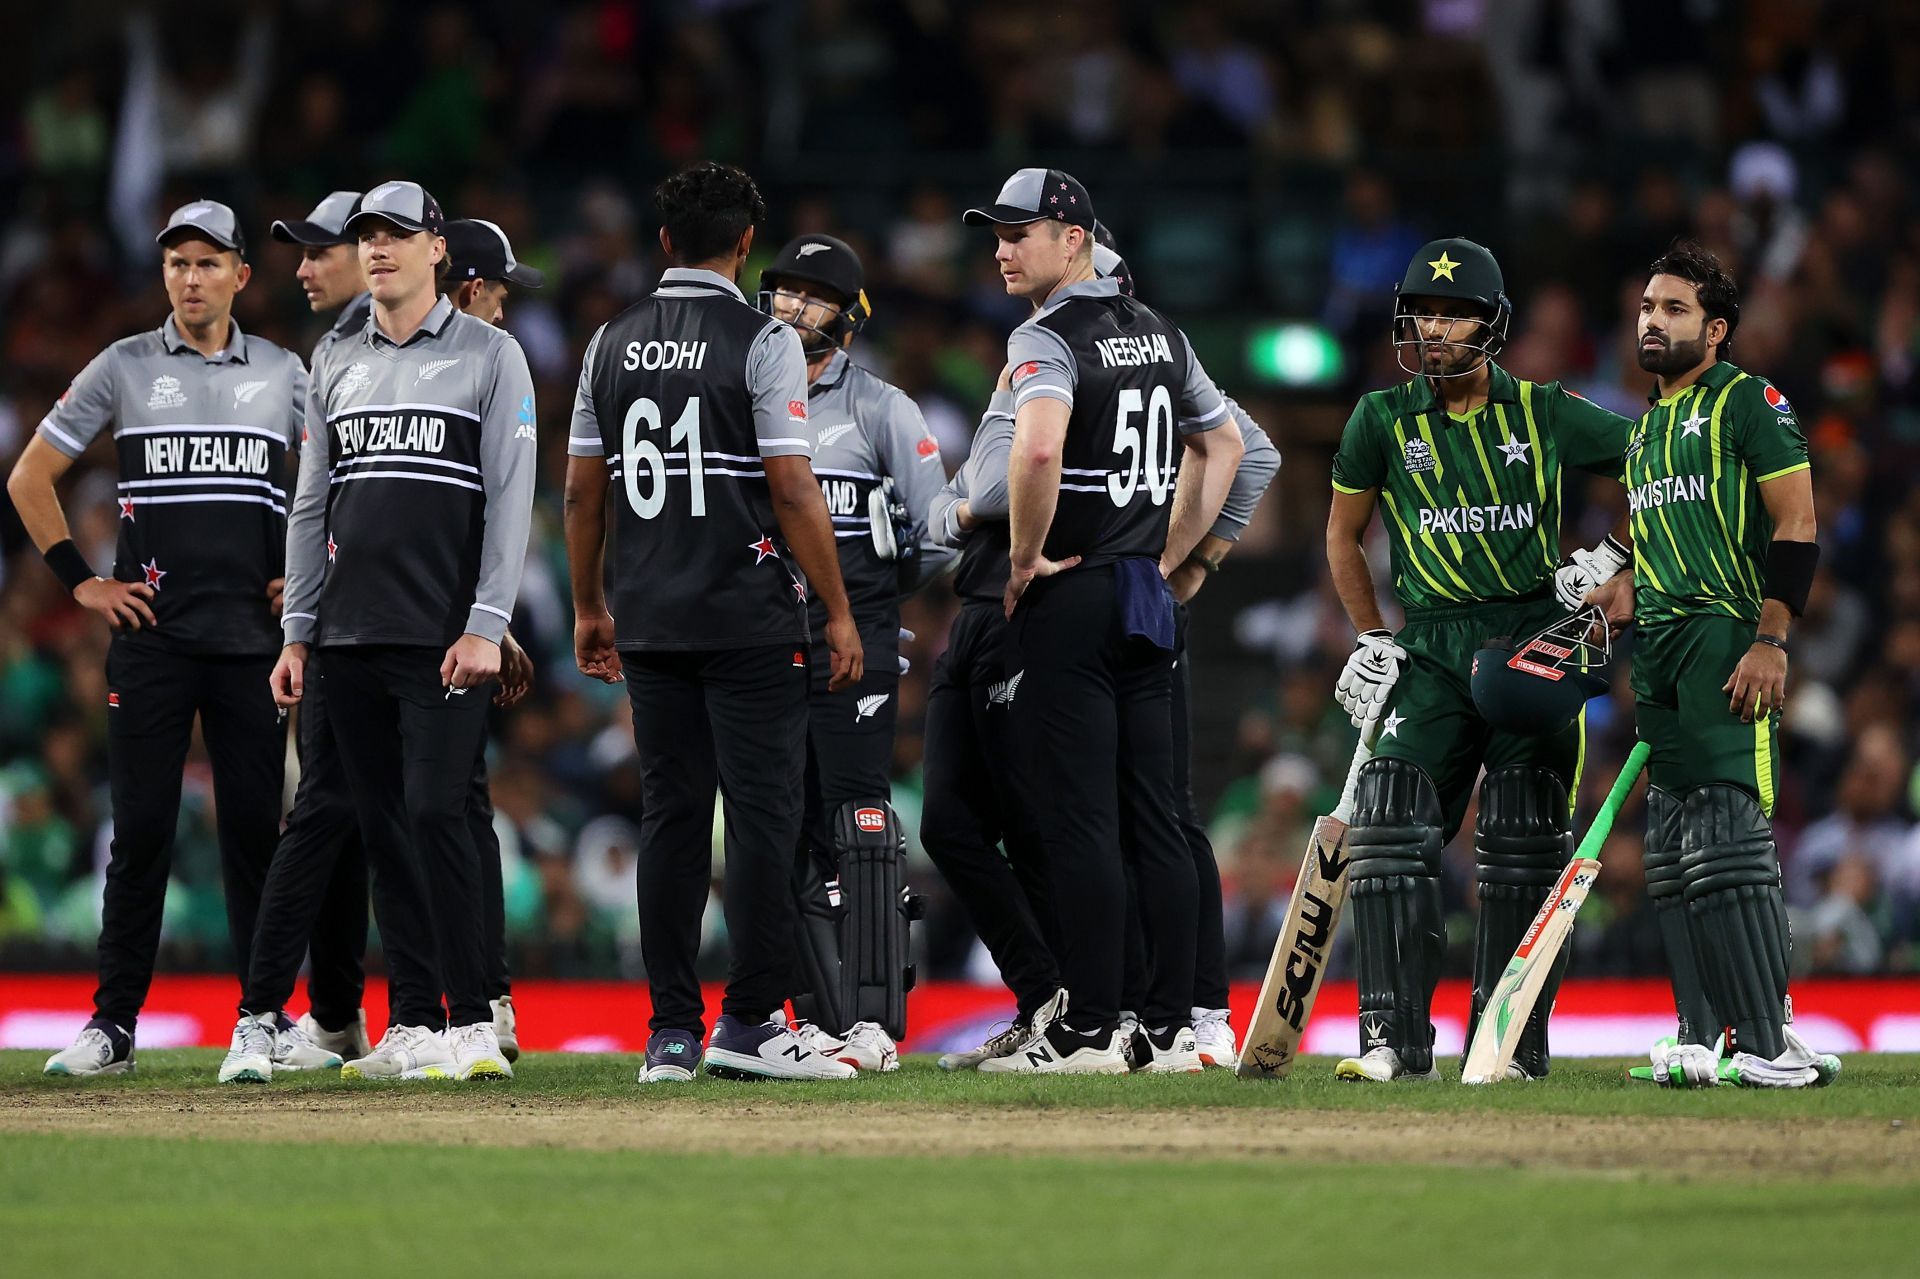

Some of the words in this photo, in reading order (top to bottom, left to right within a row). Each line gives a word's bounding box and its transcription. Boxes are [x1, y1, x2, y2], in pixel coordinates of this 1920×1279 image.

[623, 340, 708, 371] SODHI
[366, 415, 446, 454] ZEALAND
[1776, 416, 1796, 426] peps
[144, 436, 186, 475] NEW
[188, 436, 270, 475] ZEALAND
[622, 396, 707, 520] 61
[1107, 384, 1174, 508] 50
[1424, 460, 1436, 468] CUP
[1418, 502, 1534, 534] PAKISTAN
[859, 813, 883, 826] SS
[1255, 1042, 1288, 1060] Legacy
